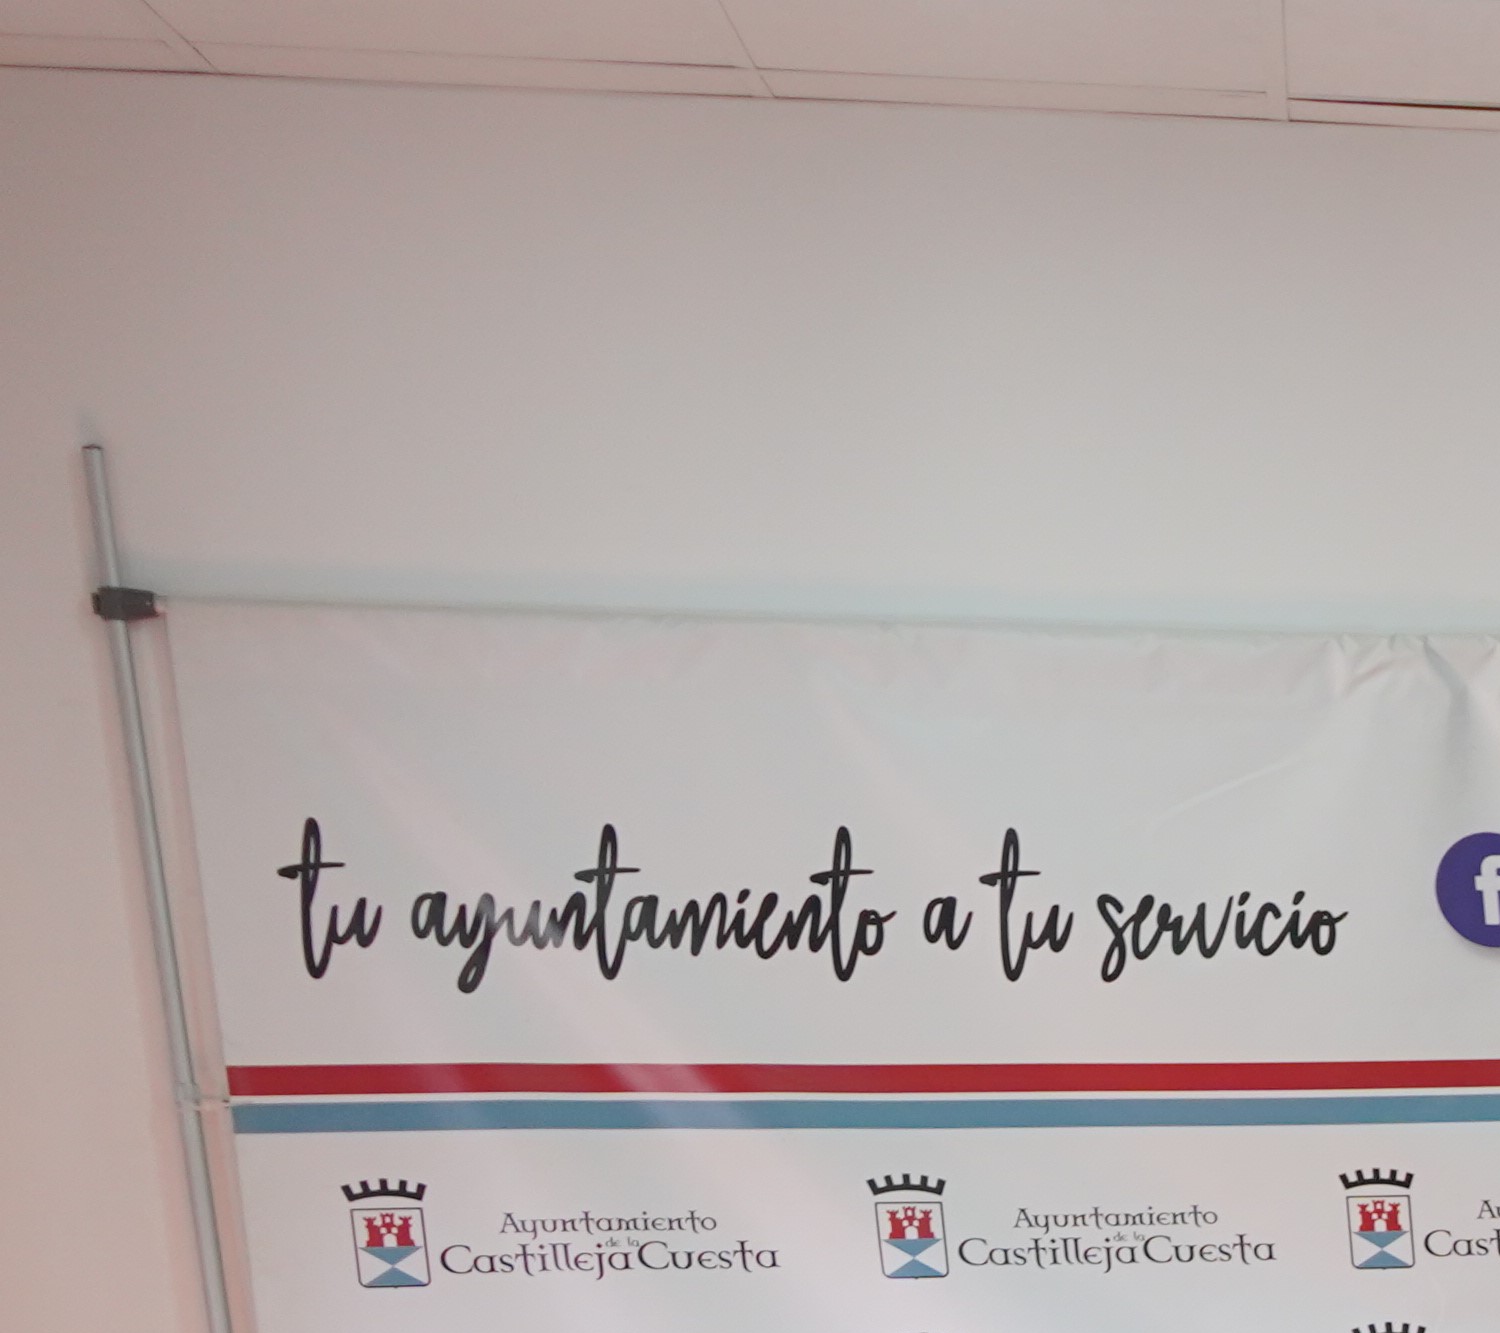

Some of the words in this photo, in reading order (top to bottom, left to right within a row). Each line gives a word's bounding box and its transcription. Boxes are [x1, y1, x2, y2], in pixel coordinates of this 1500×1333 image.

[276, 817, 383, 979] tu
[409, 823, 899, 993] ayuntamiento
[922, 890, 972, 950] a
[979, 826, 1074, 981] tu
[1098, 888, 1348, 982] servicio
[499, 1210, 717, 1240] Ayuntamiento
[1013, 1205, 1218, 1236] Ayuntamiento
